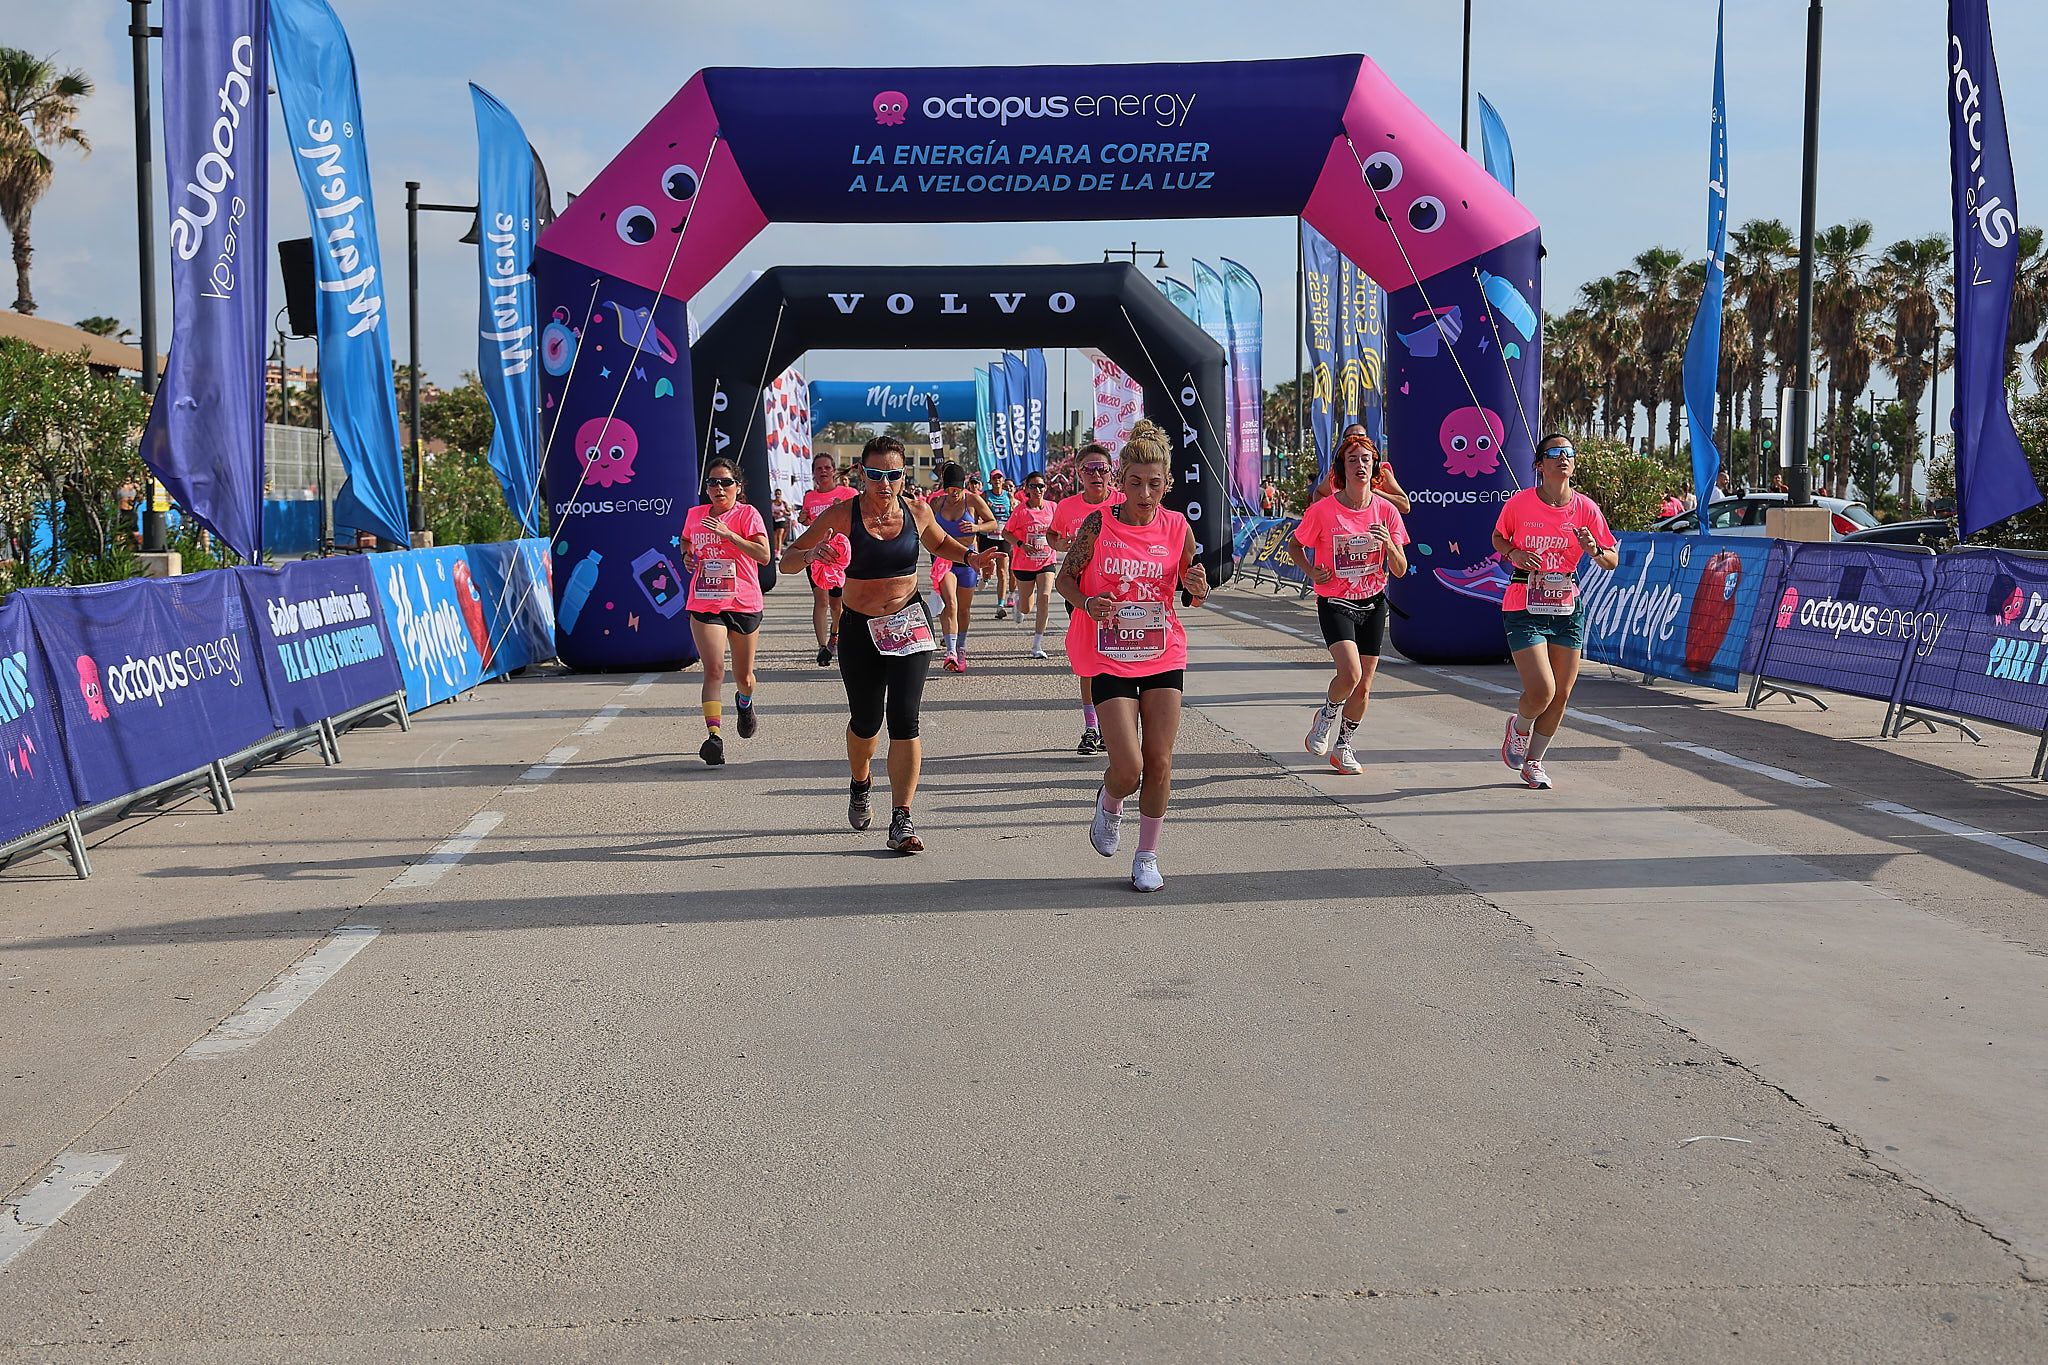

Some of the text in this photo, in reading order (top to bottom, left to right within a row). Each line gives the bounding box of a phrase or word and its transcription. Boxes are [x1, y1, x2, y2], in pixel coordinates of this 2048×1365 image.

[922, 93, 1196, 127] octopus energy
[851, 139, 1211, 165] LA ENERGÍA PARA CORRER
[848, 172, 1215, 193] A LA VELOCIDAD DE LA LUZ
[828, 292, 1076, 315] VOLVO
[866, 384, 940, 418] Marlene
[615, 498, 673, 516] energy
[1408, 489, 1524, 508] octopus ener
[1525, 535, 1570, 549] CARRERA
[1104, 556, 1164, 579] CARRERA
[1350, 553, 1368, 561] 016
[705, 577, 722, 585] 016
[1544, 590, 1563, 598] 016
[267, 597, 300, 637] Solo
[1800, 595, 1948, 657] octopus energy
[388, 563, 467, 706] Marlene
[1119, 629, 1145, 640] 016
[277, 643, 301, 683] YA
[293, 632, 319, 680] LO
[311, 633, 338, 674] HAS
[1985, 637, 2041, 684] PARA
[107, 633, 244, 707] octopus energy
